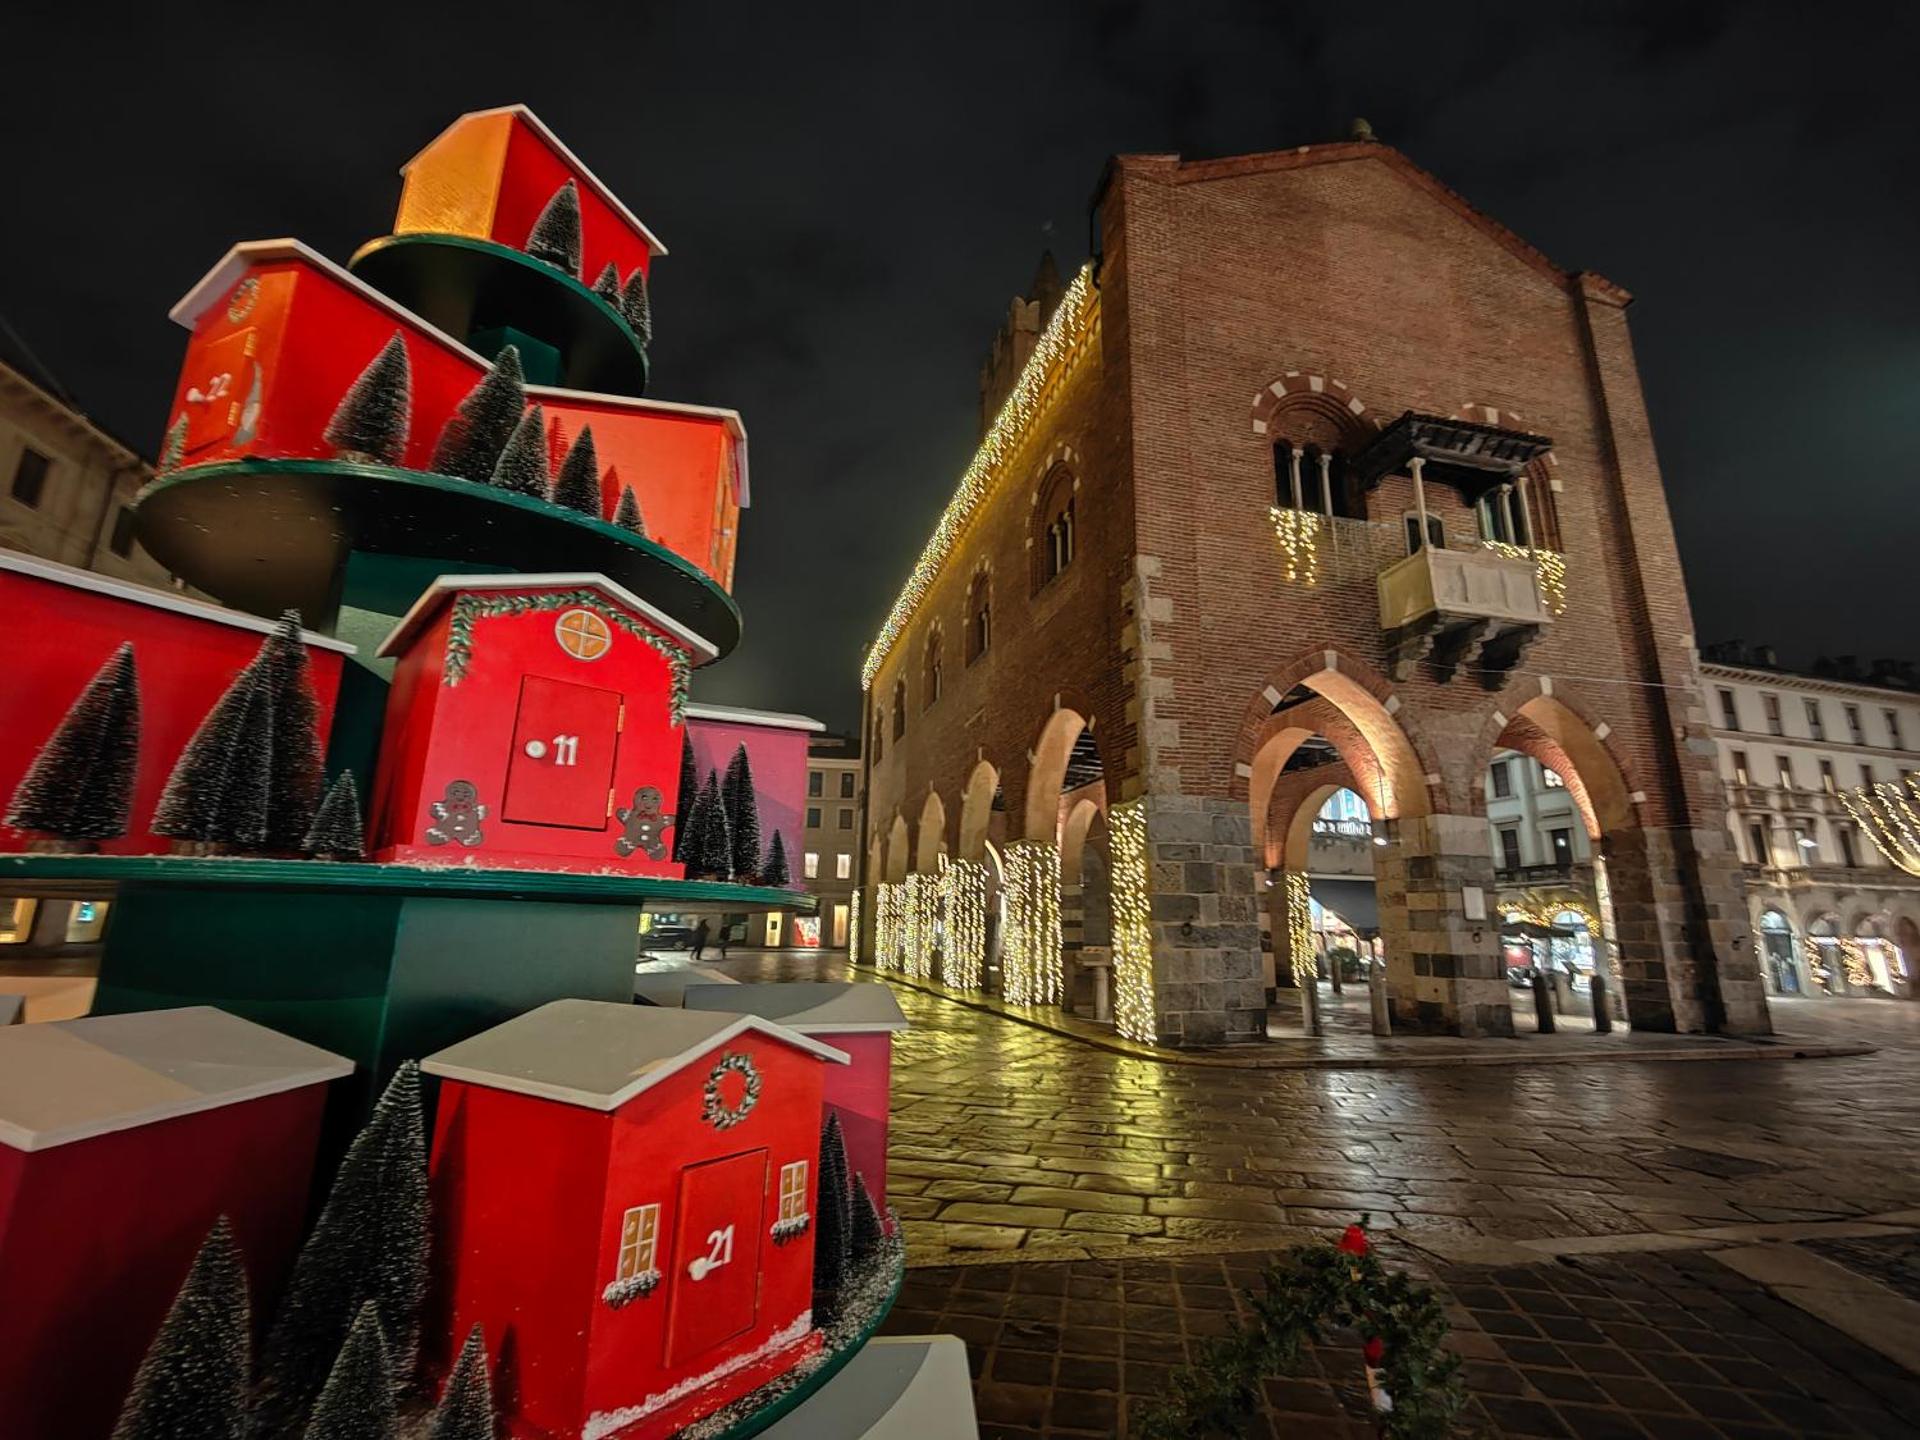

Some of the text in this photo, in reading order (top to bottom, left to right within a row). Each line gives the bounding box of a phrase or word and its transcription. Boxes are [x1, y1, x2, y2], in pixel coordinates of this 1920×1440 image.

[205, 372, 231, 401] 22
[553, 734, 579, 766] 11
[706, 1225, 734, 1271] 21
